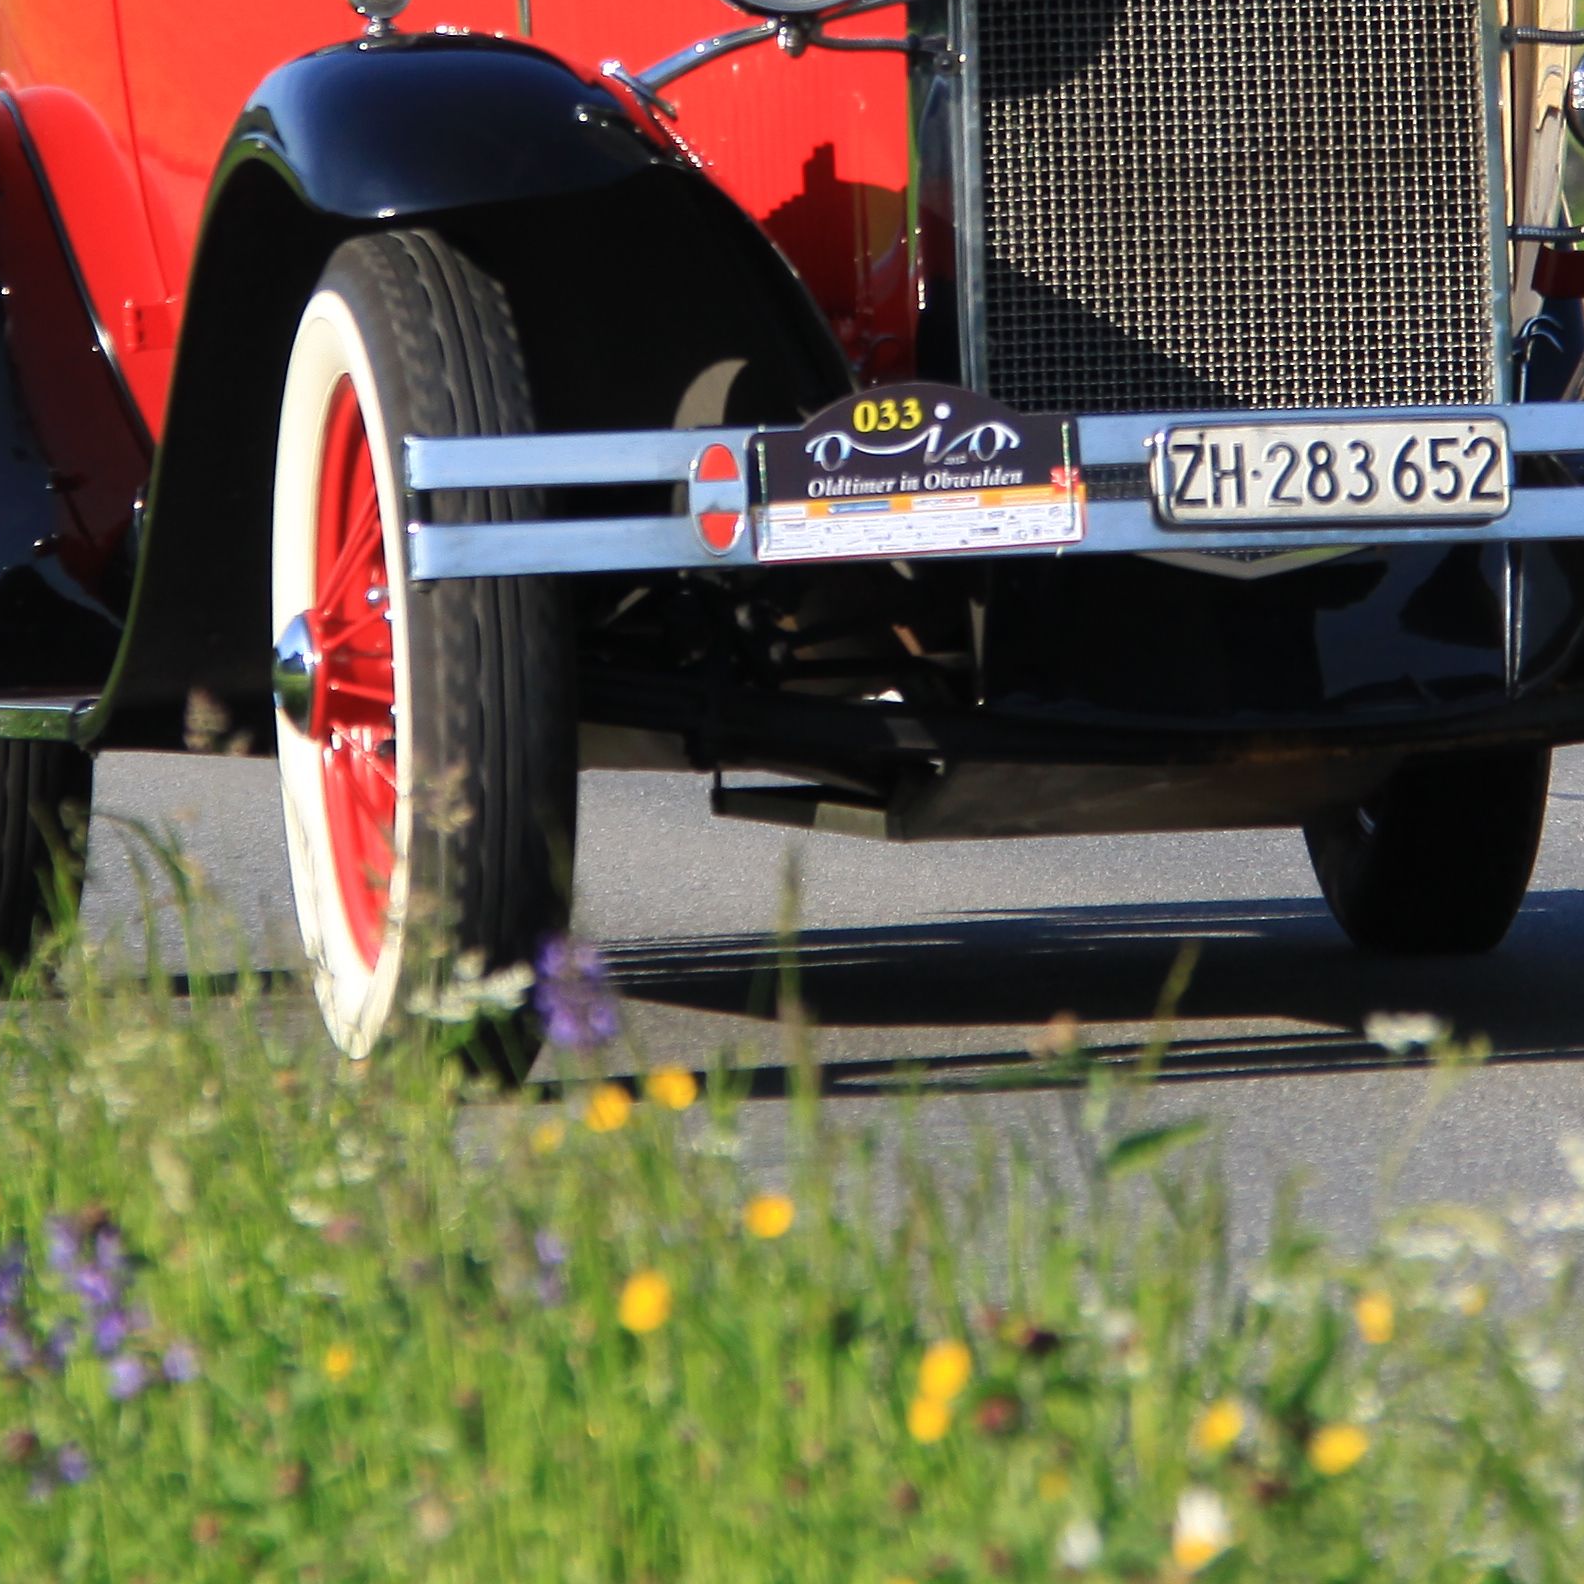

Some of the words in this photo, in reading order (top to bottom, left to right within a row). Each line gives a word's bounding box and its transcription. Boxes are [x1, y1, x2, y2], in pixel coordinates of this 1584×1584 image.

[853, 397, 922, 433] 033
[807, 473, 897, 498] Oldtimer
[900, 472, 920, 492] in
[923, 465, 1024, 491] Obwalden
